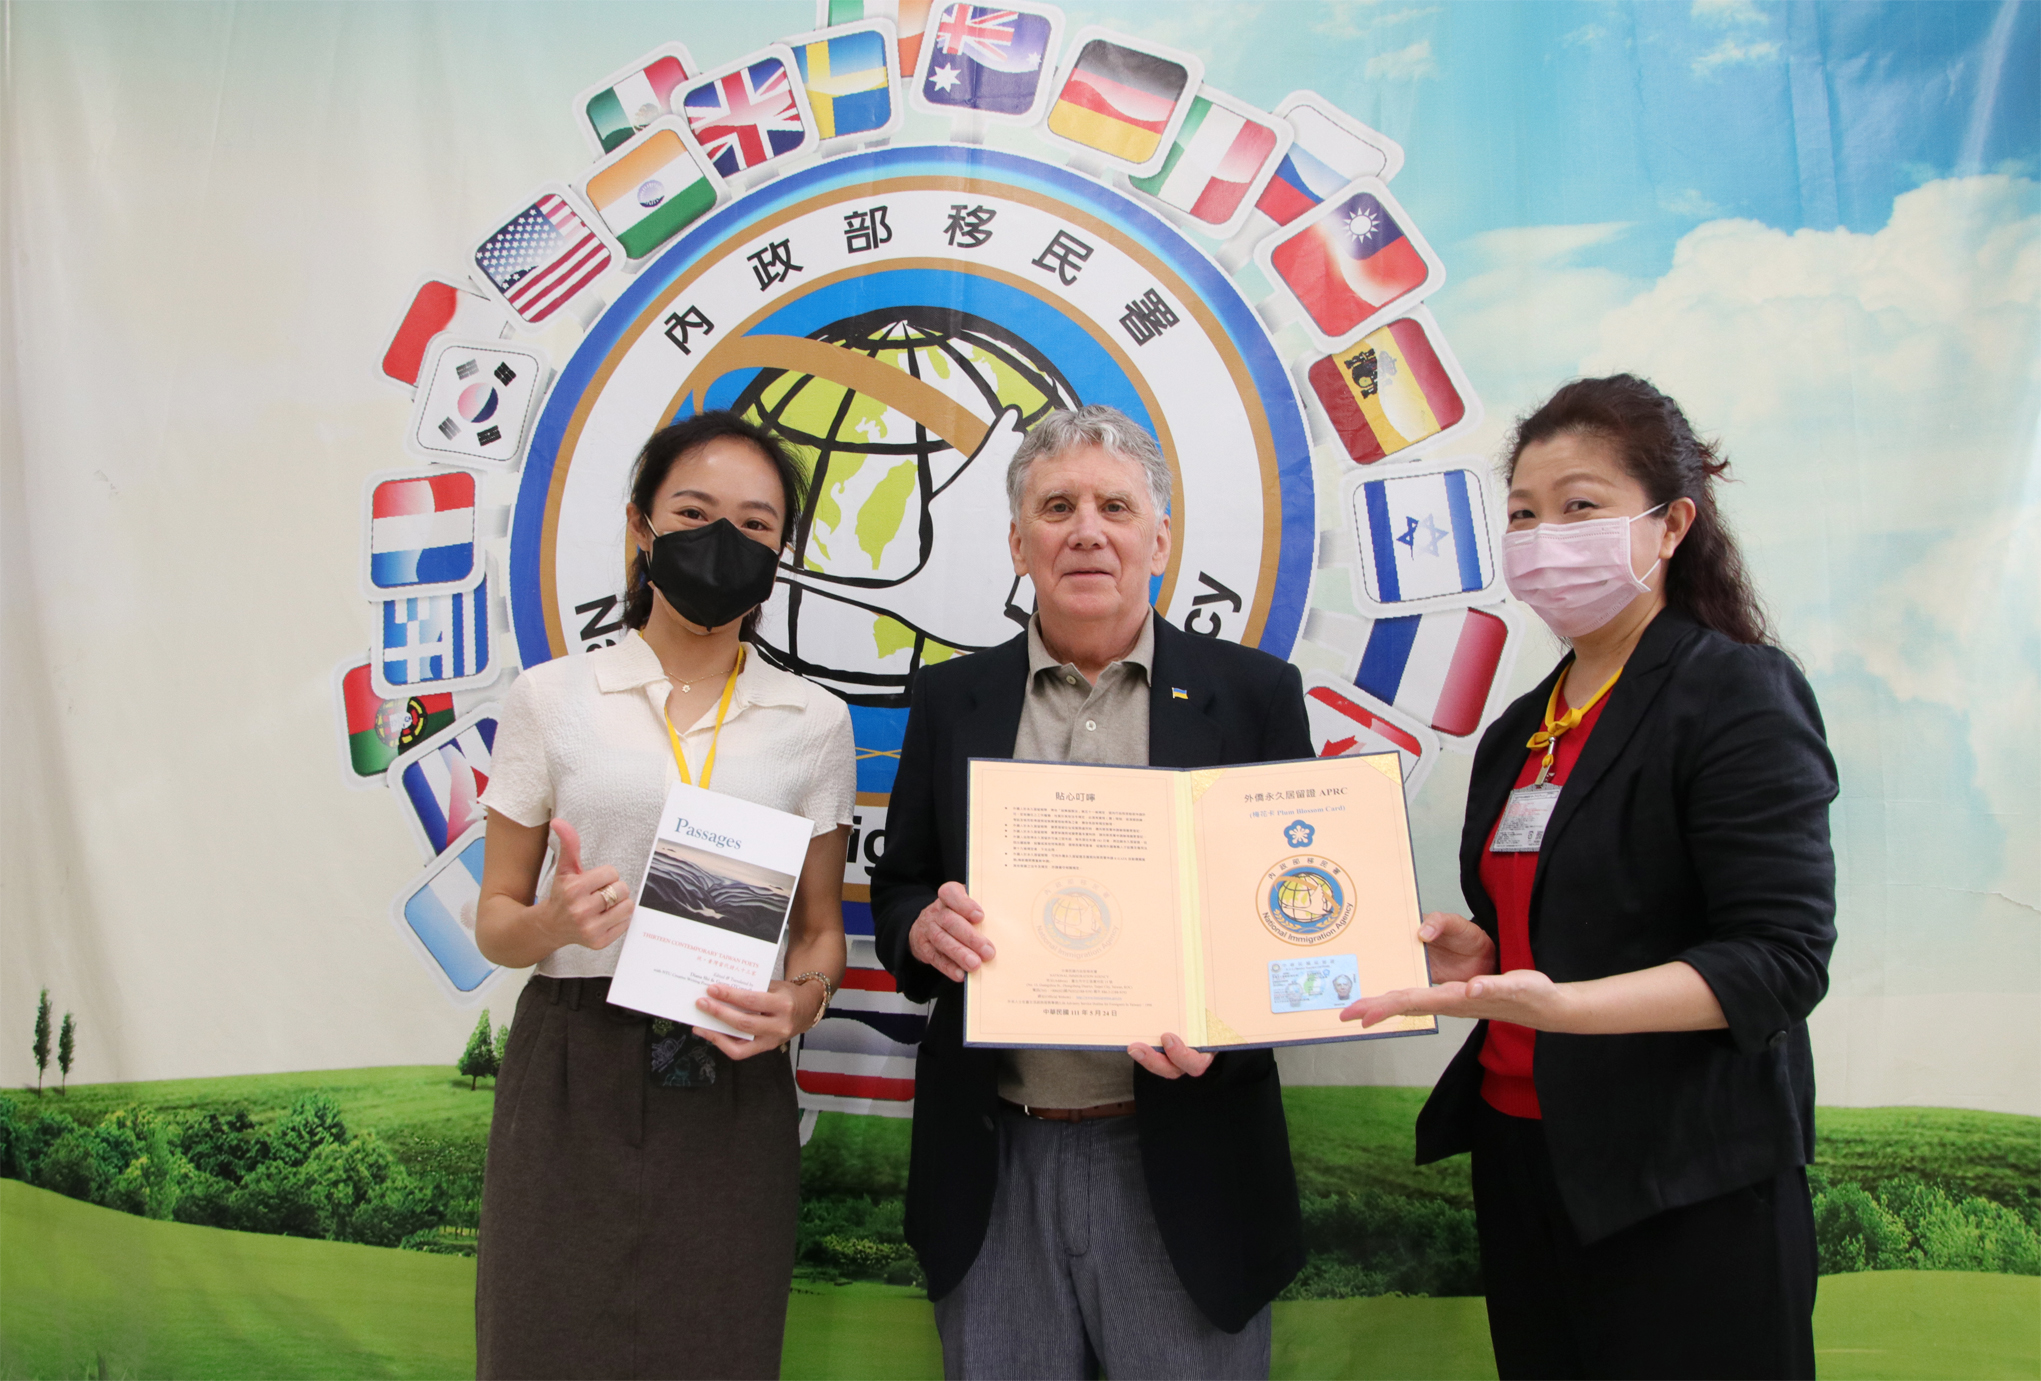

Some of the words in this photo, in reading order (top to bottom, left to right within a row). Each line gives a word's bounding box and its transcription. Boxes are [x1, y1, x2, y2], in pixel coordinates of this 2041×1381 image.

[664, 204, 1180, 354] 內政部移民署
[1055, 791, 1096, 802] 貼心叮嚀
[1244, 789, 1316, 803] 外僑永久居留證
[1319, 787, 1348, 797] APRC
[1296, 806, 1324, 815] Blossom
[674, 817, 742, 850] Passages
[1262, 912, 1287, 938] National
[1288, 928, 1336, 944] Immigration
[1335, 902, 1354, 930] Agency
[643, 932, 671, 943] THIRTEEN
[672, 940, 717, 956] CONTEMPORARY
[719, 952, 741, 963] TAIWAN
[741, 959, 759, 968] POETS
[1036, 925, 1059, 951] National
[1101, 925, 1120, 949] Agency
